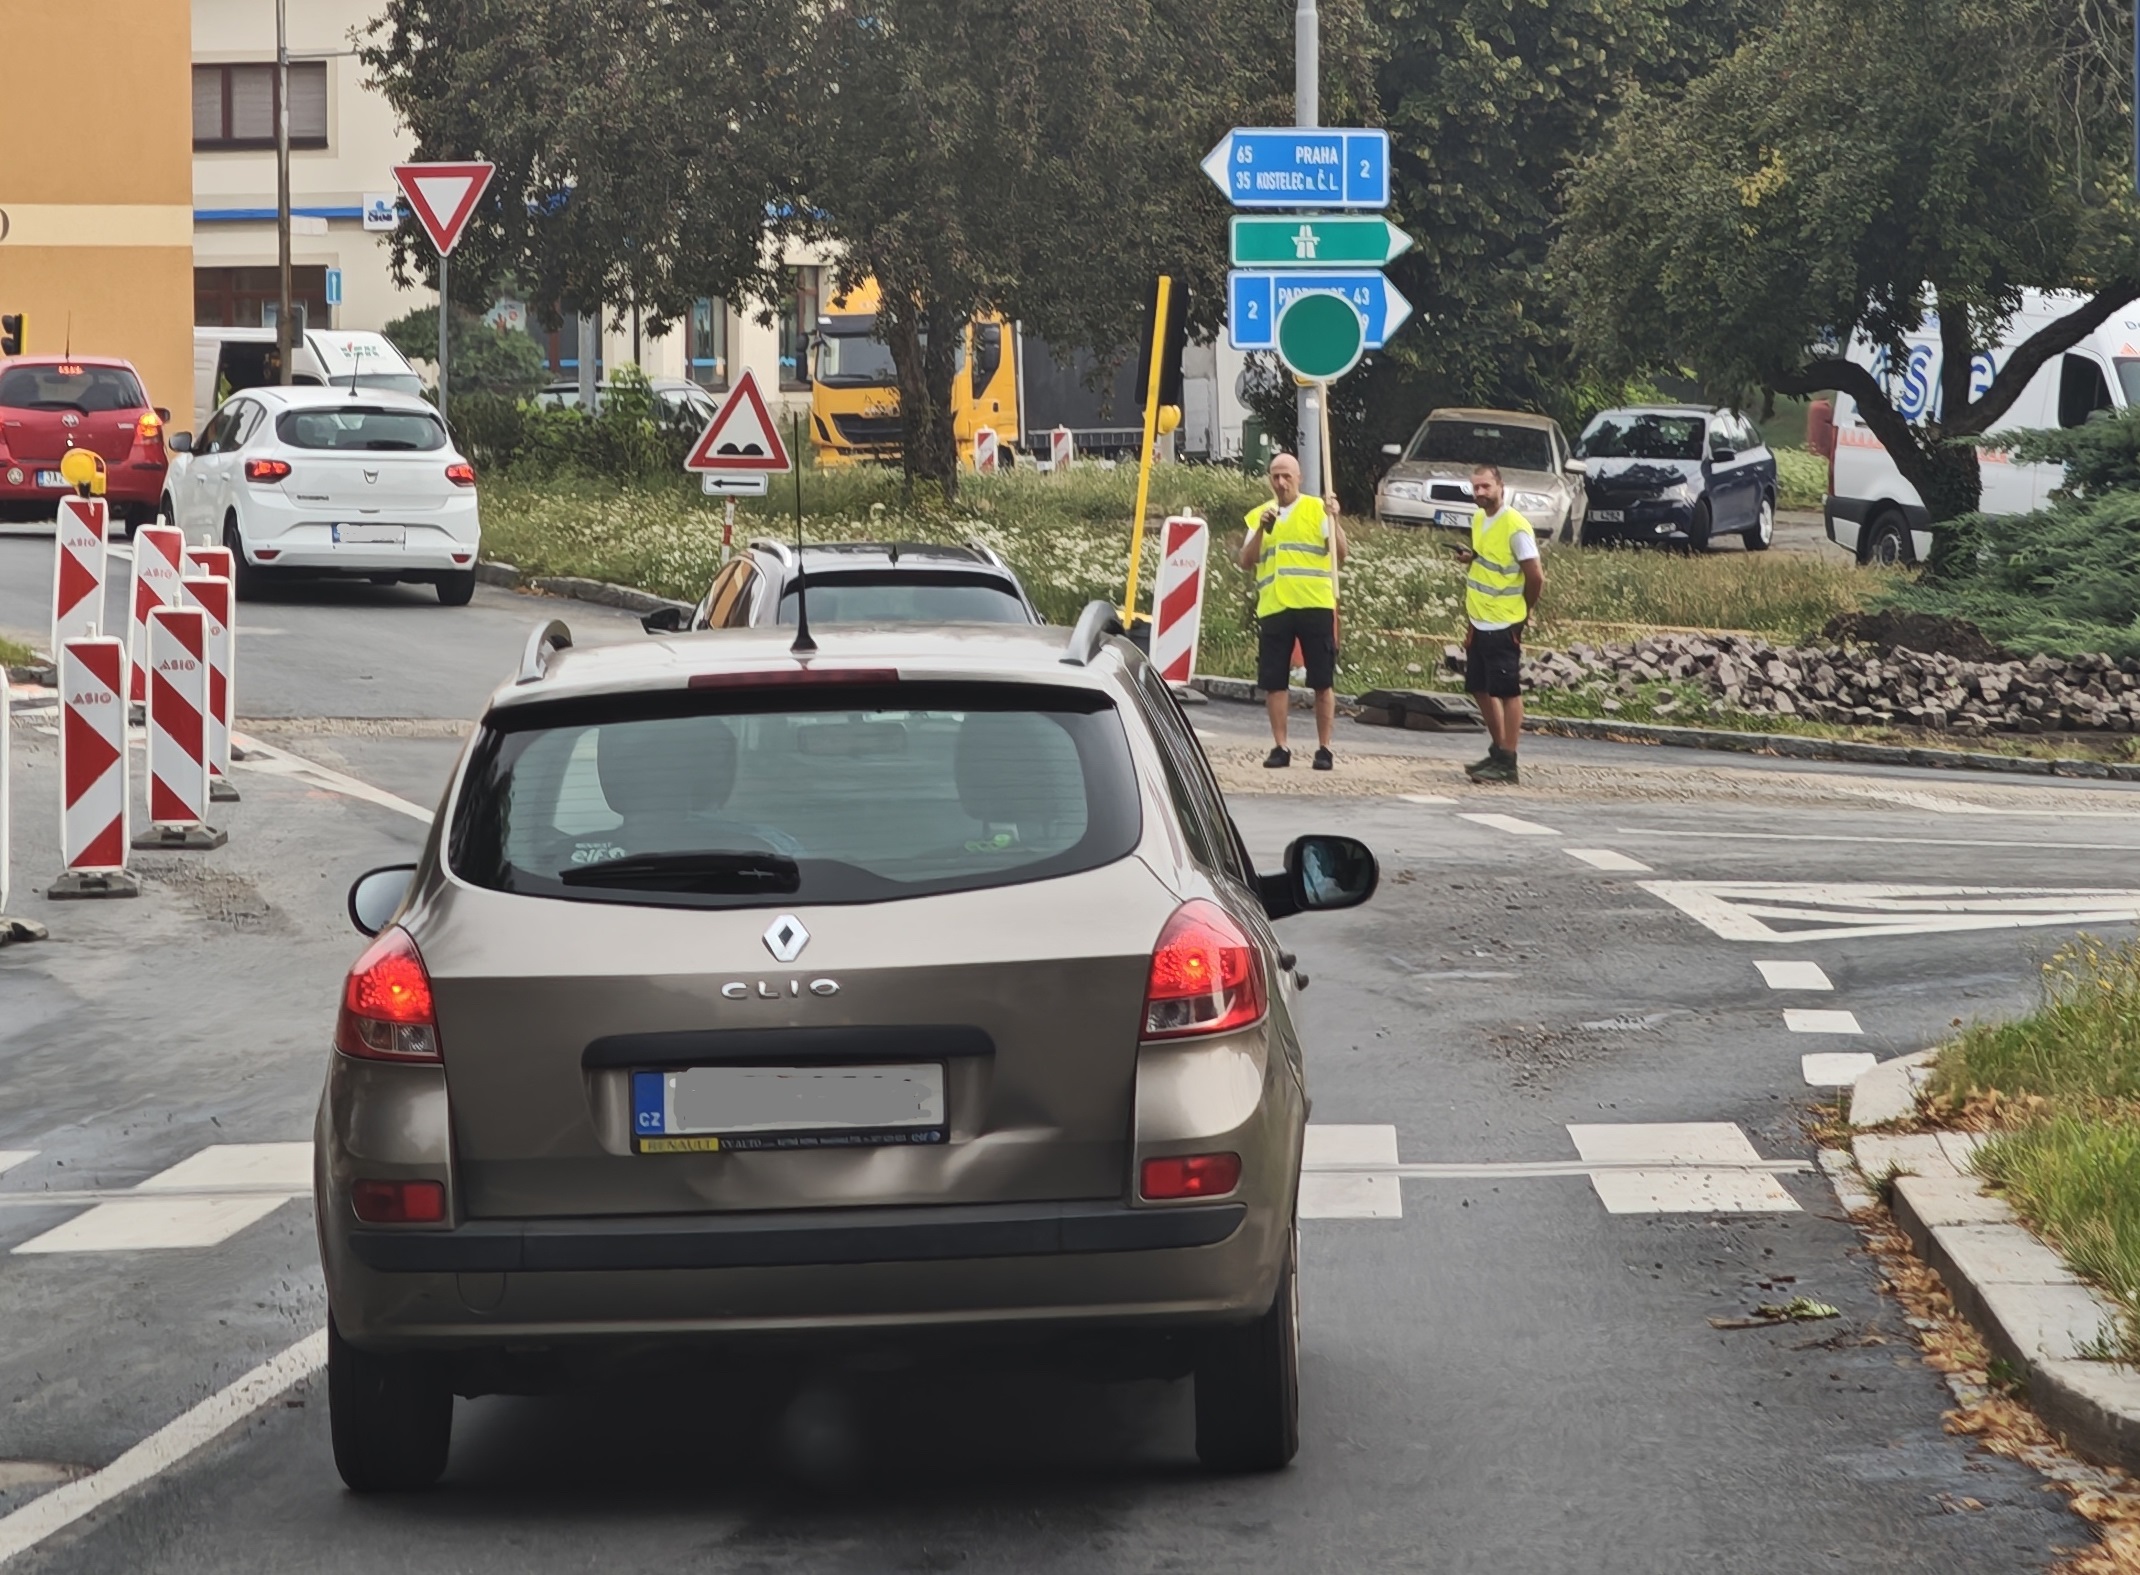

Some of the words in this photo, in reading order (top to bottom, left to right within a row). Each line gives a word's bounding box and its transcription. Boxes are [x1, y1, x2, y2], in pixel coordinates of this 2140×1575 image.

[1236, 145, 1253, 164] 65
[1295, 145, 1339, 165] PRAHA
[1359, 159, 1370, 179] 2
[1236, 171, 1251, 190] 35
[1256, 171, 1304, 191] KOSTELEC
[1353, 287, 1370, 305] 43
[1247, 301, 1258, 320] 2
[721, 977, 841, 1001] CLIO
[639, 1111, 661, 1127] CZ
[647, 1138, 711, 1151] RENAULT
